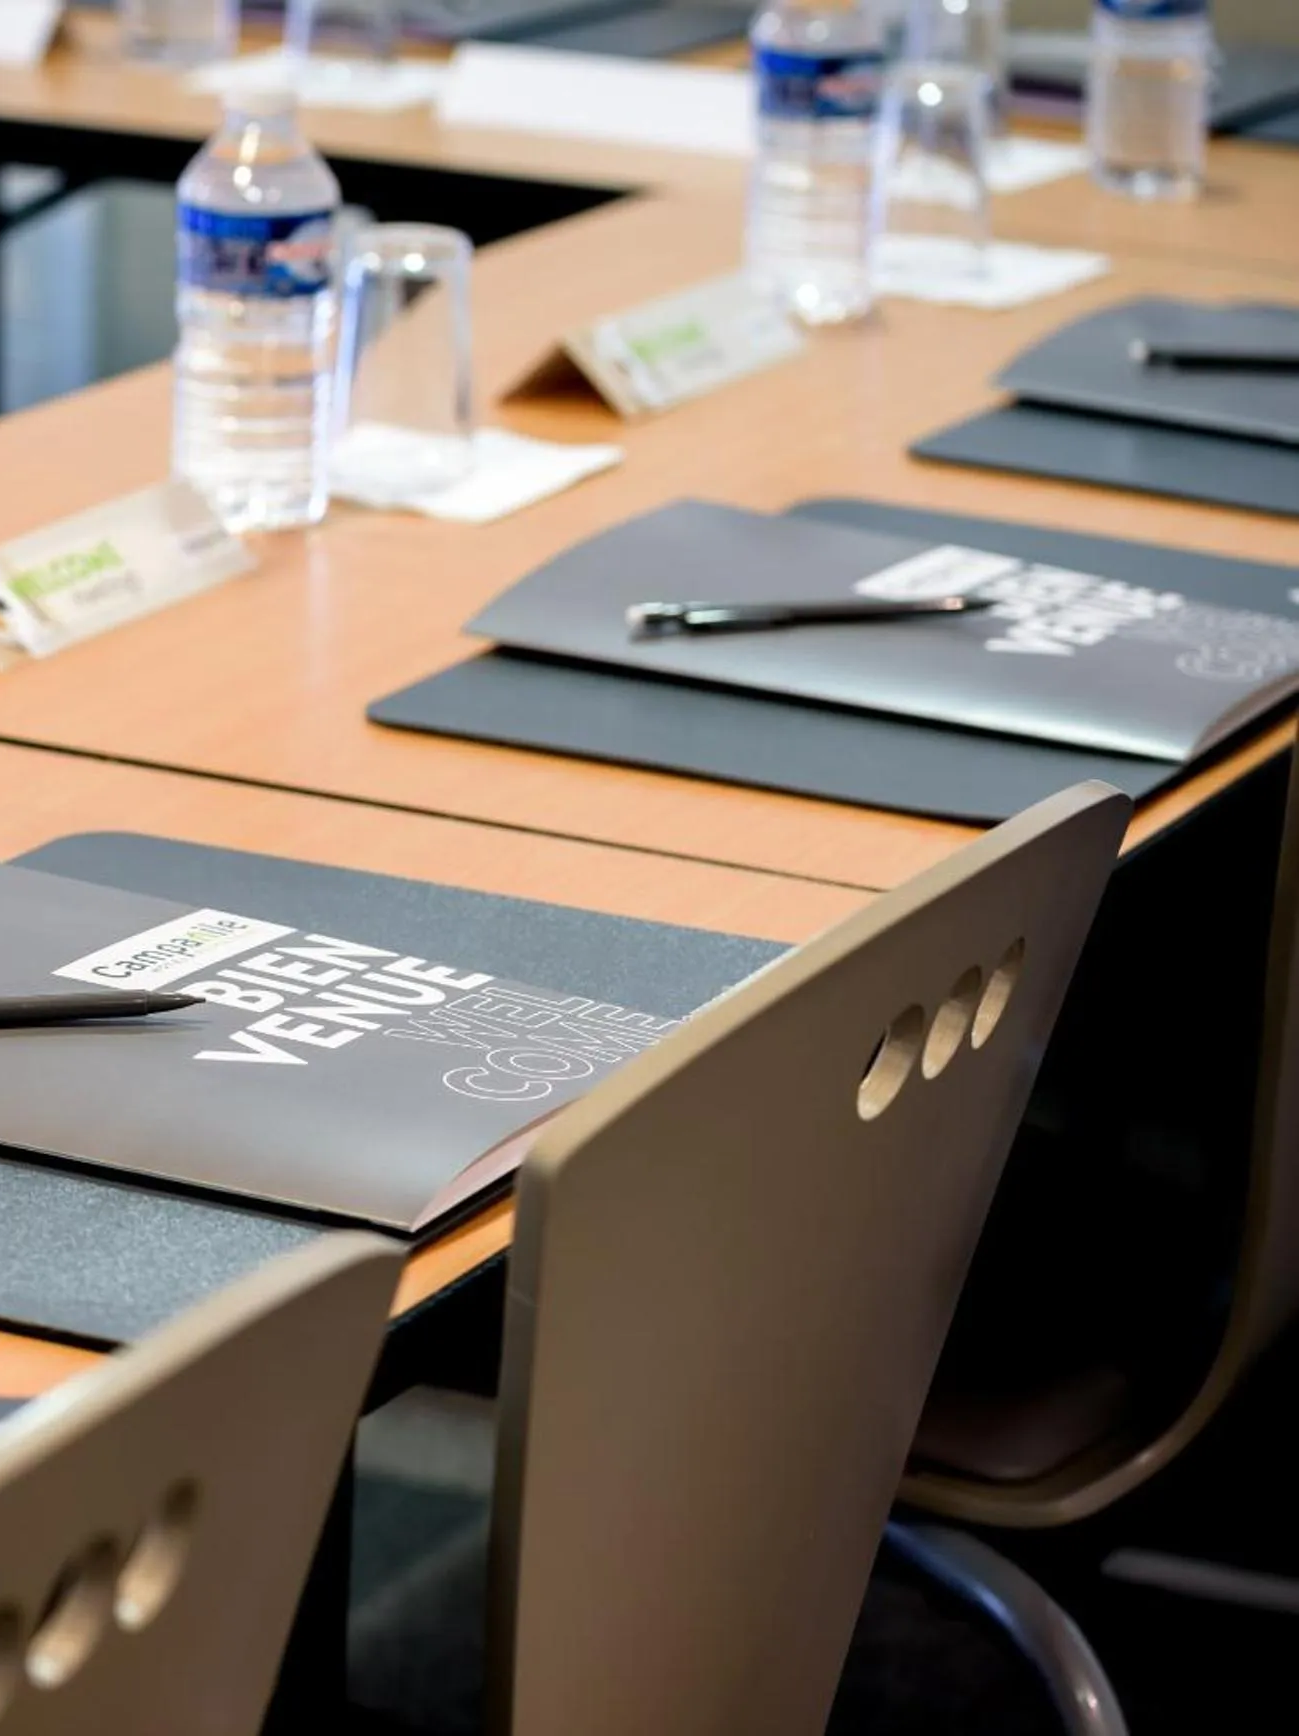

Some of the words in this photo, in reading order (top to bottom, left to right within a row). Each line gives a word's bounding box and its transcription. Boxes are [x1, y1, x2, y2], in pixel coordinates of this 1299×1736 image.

[91, 918, 248, 982] Campanile
[174, 933, 400, 1013] BIEN
[193, 956, 495, 1066] VENUE
